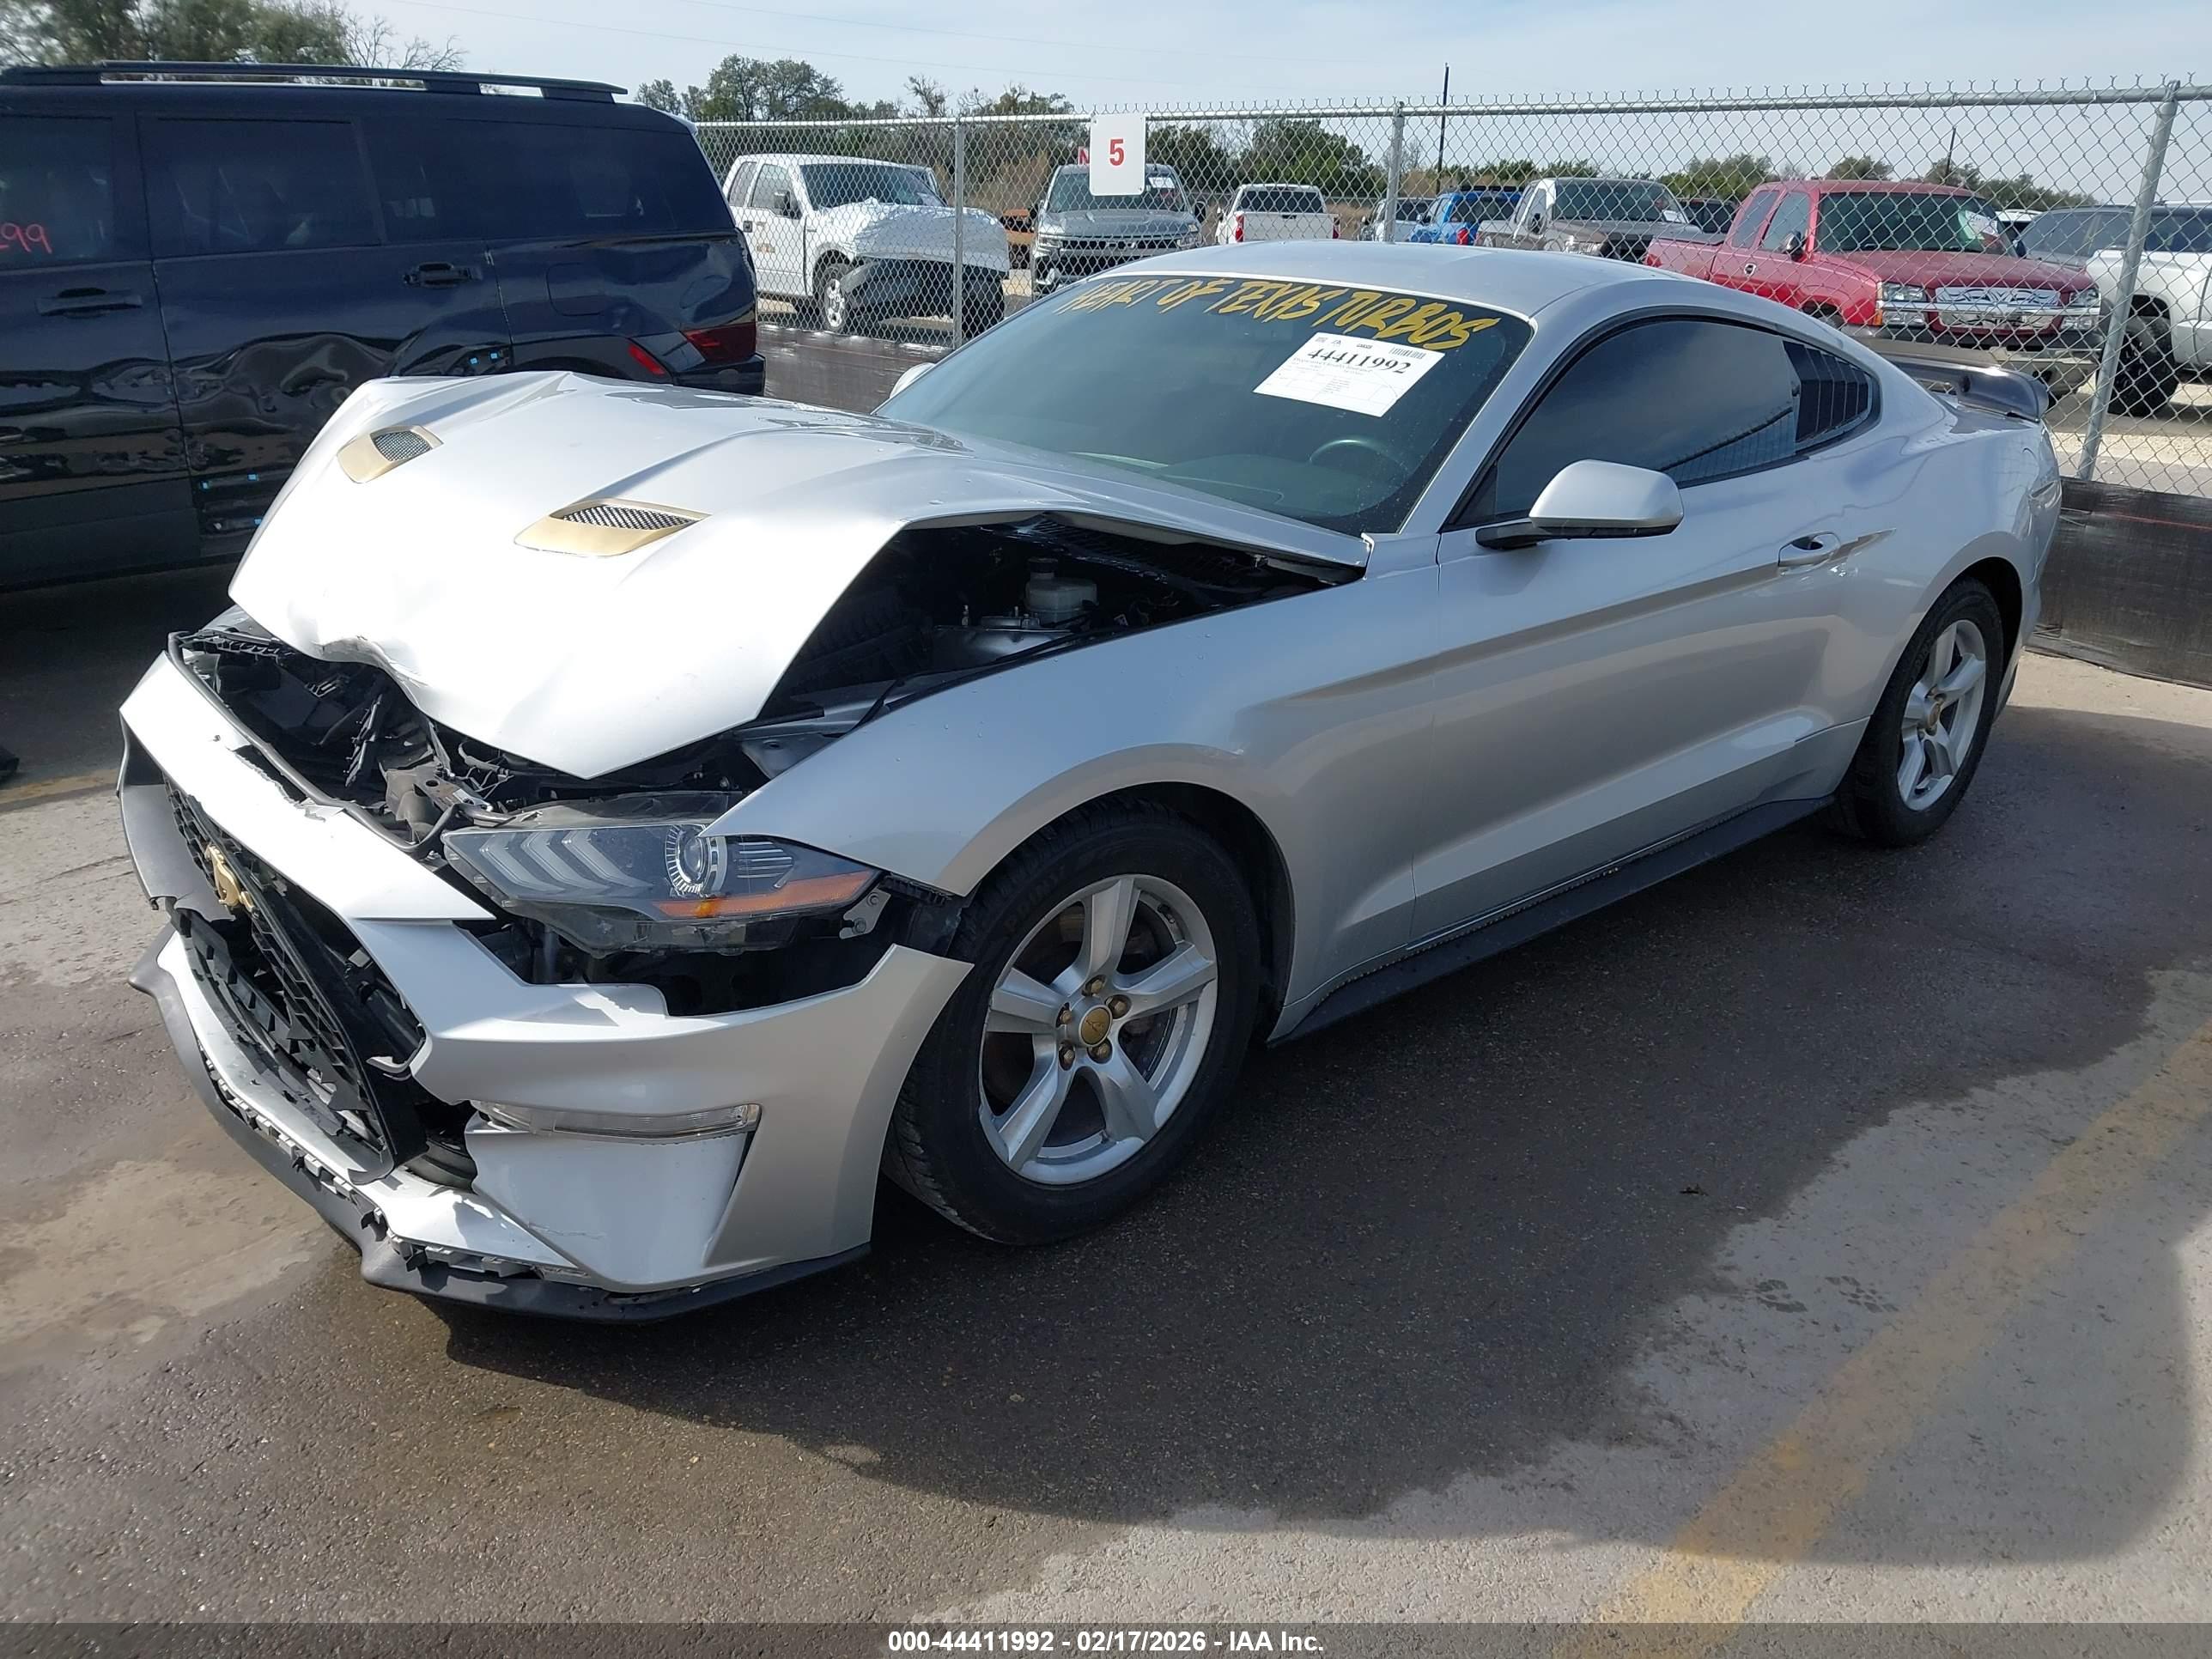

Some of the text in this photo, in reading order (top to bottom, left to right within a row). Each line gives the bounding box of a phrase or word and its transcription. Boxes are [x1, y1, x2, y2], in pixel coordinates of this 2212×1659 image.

[1109, 138, 1125, 167] 5
[0, 222, 52, 254] 99
[1052, 277, 1502, 350] HEART OF TEXAS TURBOS
[1307, 348, 1412, 374] 44411992
